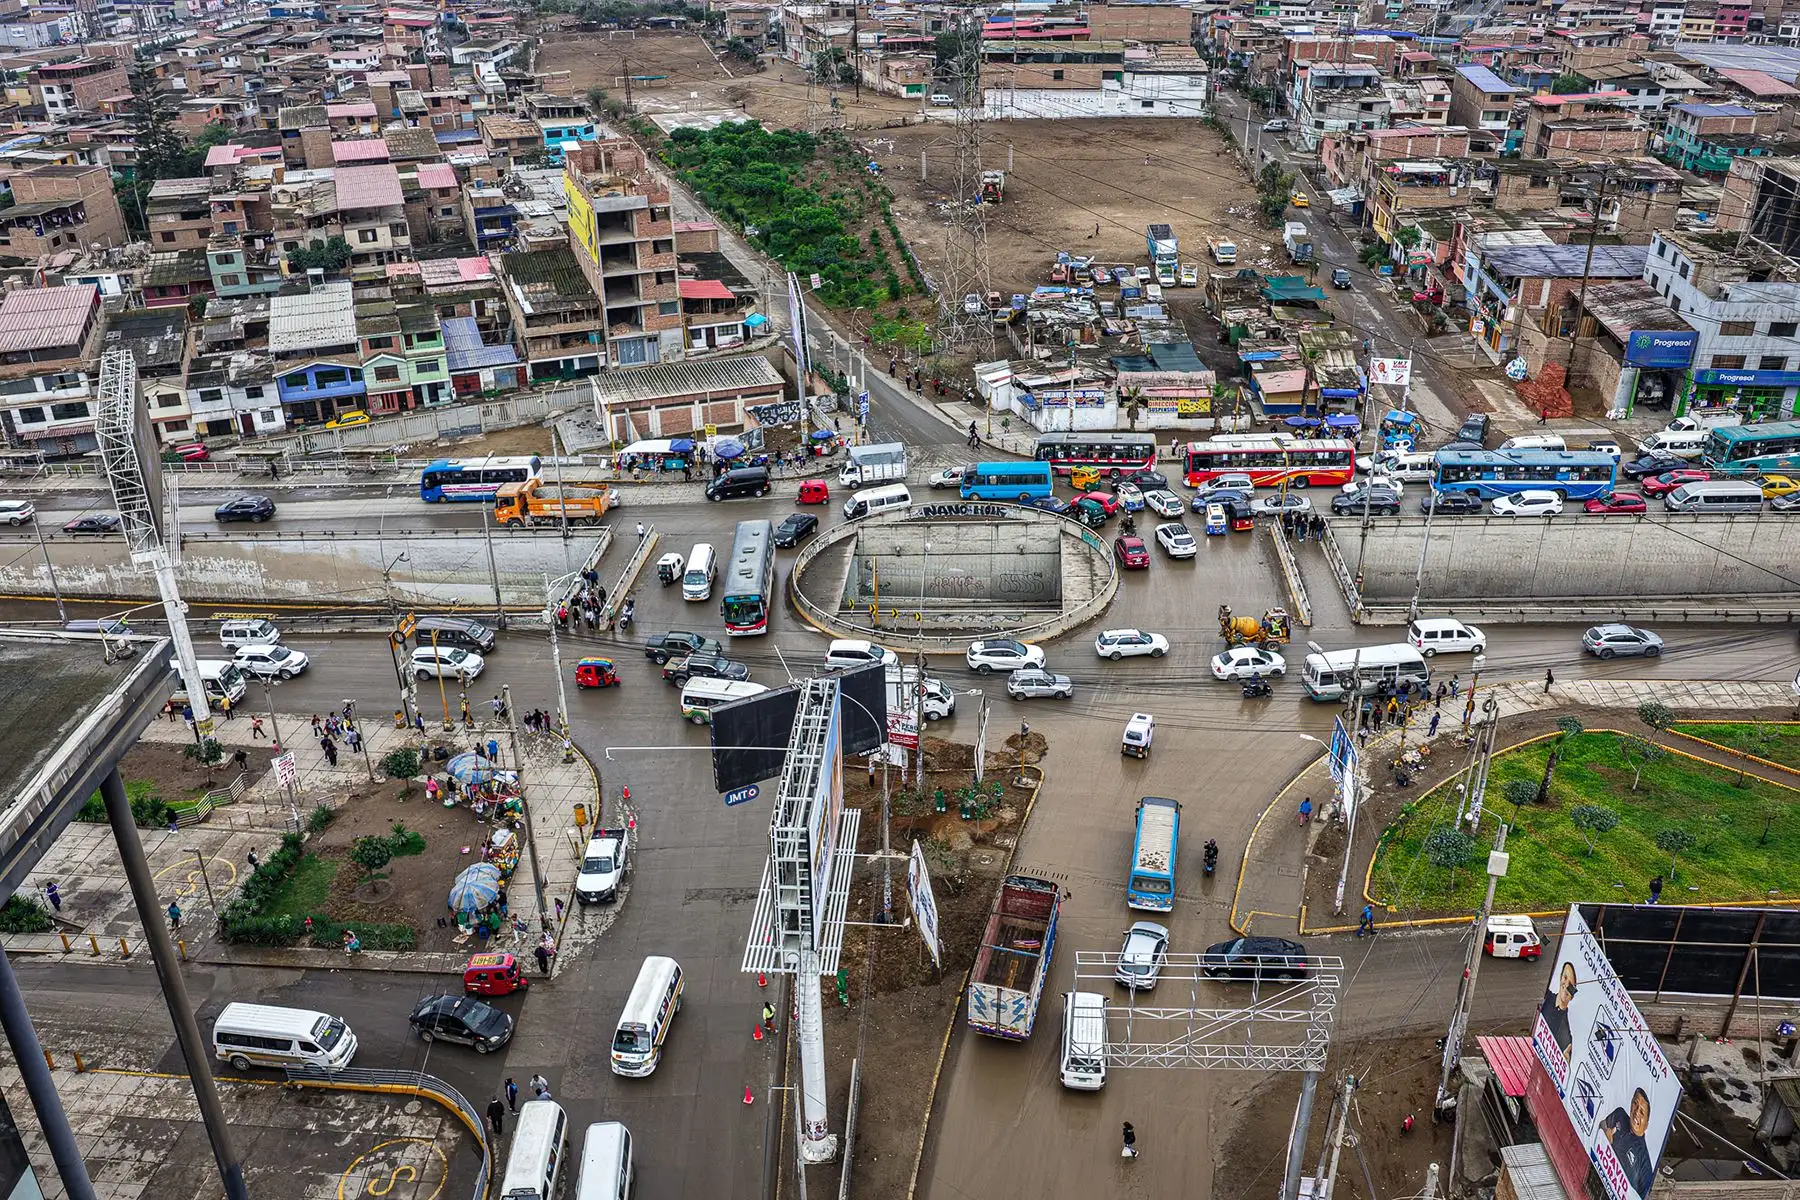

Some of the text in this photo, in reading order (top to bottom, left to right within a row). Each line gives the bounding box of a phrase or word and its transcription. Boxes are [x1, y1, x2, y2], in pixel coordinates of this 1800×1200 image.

[1654, 339, 1692, 348] Progresol
[1720, 373, 1755, 383] Progresol
[1579, 940, 1660, 1083] Y CON OBRAS DE CALIDAD!
[1616, 988, 1644, 1038] SEGURA,
[1644, 1035, 1669, 1079] LIMPIA
[1537, 1031, 1565, 1085] ALLISON
[1540, 1018, 1568, 1073] FRANCIS
[1605, 1144, 1628, 1193] DAVID
